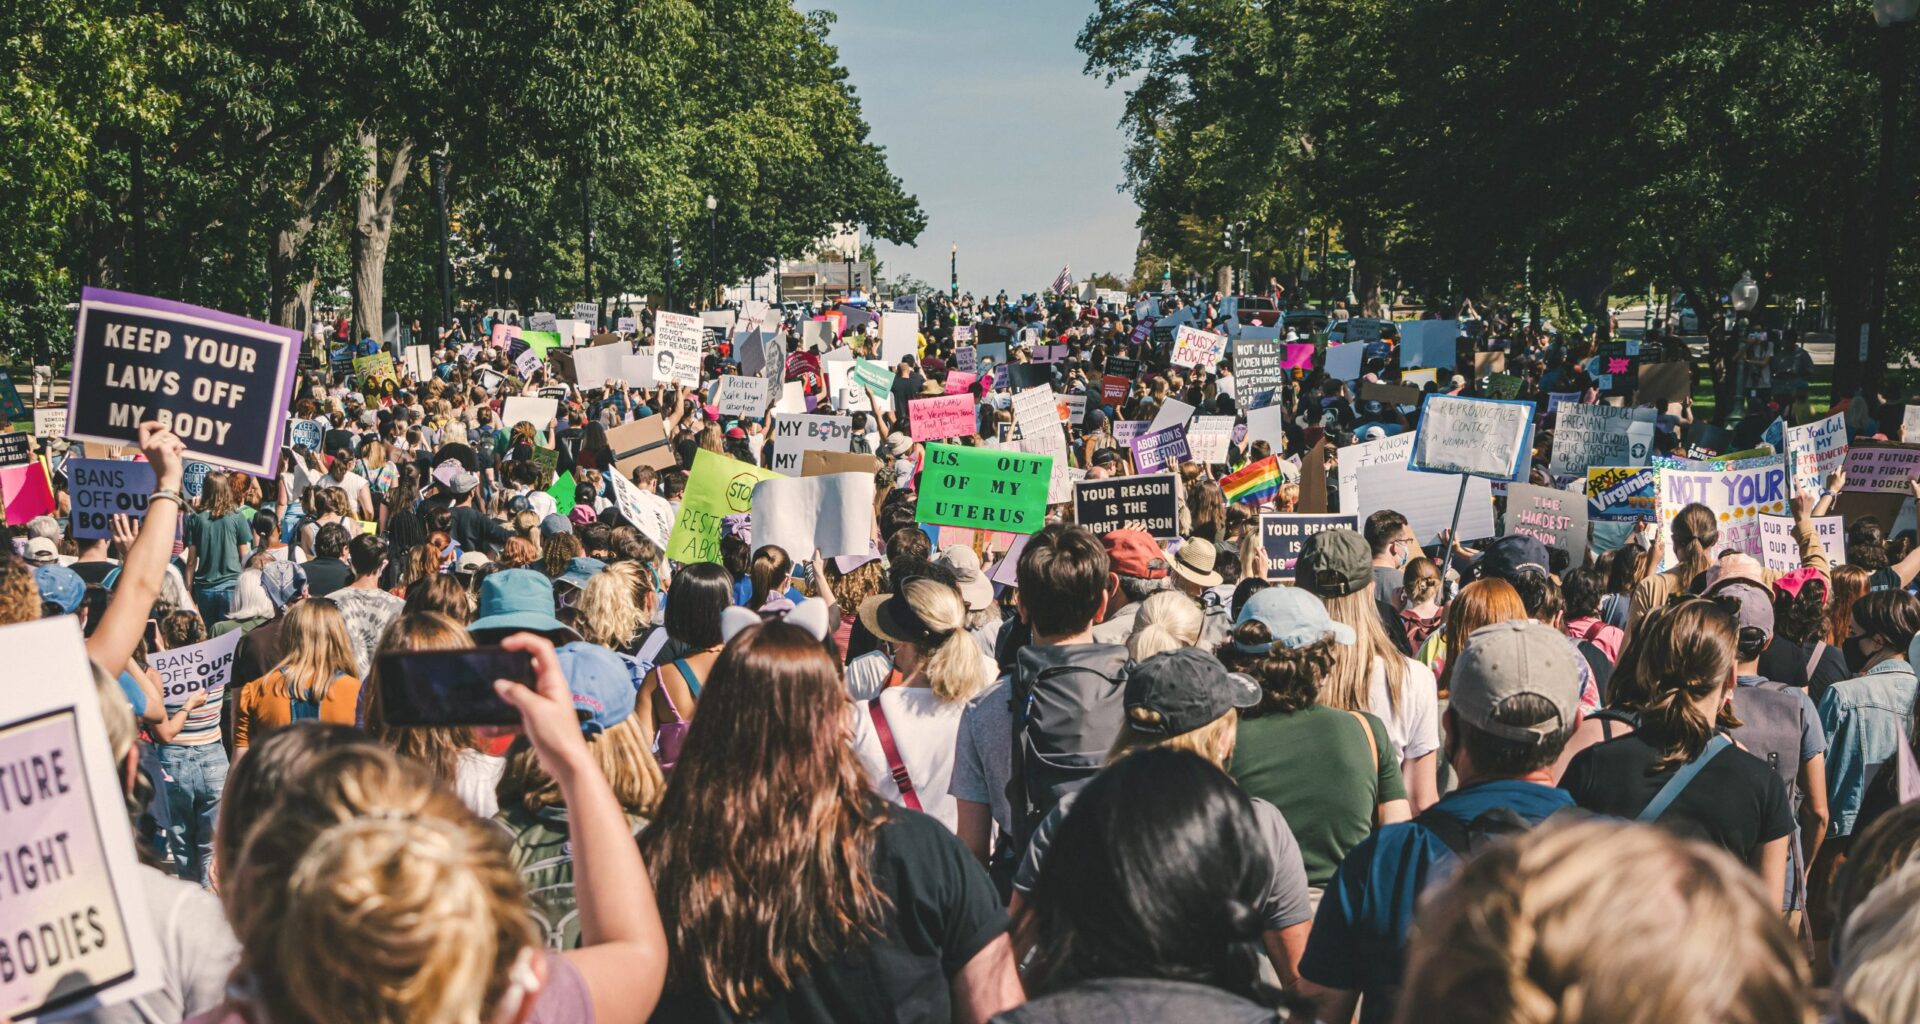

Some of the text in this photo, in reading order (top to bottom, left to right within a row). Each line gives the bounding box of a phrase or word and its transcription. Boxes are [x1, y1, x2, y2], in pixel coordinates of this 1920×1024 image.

[659, 334, 697, 345] GOVERNED
[670, 342, 699, 352] REASON
[1185, 333, 1217, 350] PUSSY
[104, 322, 258, 373] KEEP YOUR
[1237, 344, 1276, 356] NOT ALL
[1178, 348, 1217, 368] POWER
[1235, 356, 1280, 368] WOMEN HAVE
[1264, 367, 1280, 376] AND
[105, 362, 246, 409] LAWS OFF
[728, 376, 760, 389] Protect
[1236, 378, 1250, 388] NOT
[726, 403, 756, 413] abortion
[1440, 402, 1517, 422] REPRODUCTIVE
[1571, 402, 1588, 414] MEN
[1592, 406, 1617, 419] COULD
[1620, 407, 1634, 420] GET
[108, 402, 232, 446] MY BODY
[298, 420, 318, 430] KEEP
[778, 421, 802, 436] MY
[1452, 421, 1498, 436] CONTROL
[1562, 414, 1607, 431] PREGNANT
[1137, 428, 1182, 452] ABORTION IS
[1554, 430, 1582, 441] ABORTION
[1583, 431, 1610, 444] CLINICS
[1806, 426, 1825, 439] You
[1362, 435, 1409, 456] I KNOW
[1432, 434, 1438, 442] A
[1442, 438, 1479, 449] WOMAN'S
[1481, 441, 1510, 455] RIGHT
[1816, 436, 1832, 450] MY
[774, 453, 798, 468] MY
[932, 450, 1042, 474] U.S. OUT
[1141, 443, 1187, 466] FREEDOM
[1850, 452, 1920, 463] OUR FUTURE
[188, 462, 210, 474] KEEP
[1852, 465, 1912, 476] OUR FIGHT
[74, 468, 125, 489] BANS
[943, 474, 1022, 496] OF MY
[1845, 478, 1910, 490] OUR BODIES
[1082, 483, 1170, 502] YOUR REASON
[1588, 470, 1653, 512] Virginia
[1668, 469, 1784, 506] NOT YOUR
[77, 490, 150, 511] OFF OU
[1533, 496, 1562, 510] THE
[1628, 496, 1656, 509] VOT
[935, 502, 1025, 524] UTERUS
[1106, 502, 1148, 516] IS THE
[1520, 510, 1571, 530] HARDEST
[1267, 524, 1300, 536] YOUR
[1763, 522, 1782, 535] OUR
[1290, 542, 1302, 552] IS
[1769, 541, 1787, 554] OUR
[1768, 558, 1784, 572] OUR
[156, 650, 204, 671] BANS
[160, 652, 233, 685] OFF OUR
[163, 670, 225, 698] BODIES
[0, 748, 70, 812] TURE
[0, 831, 74, 895] IGHT
